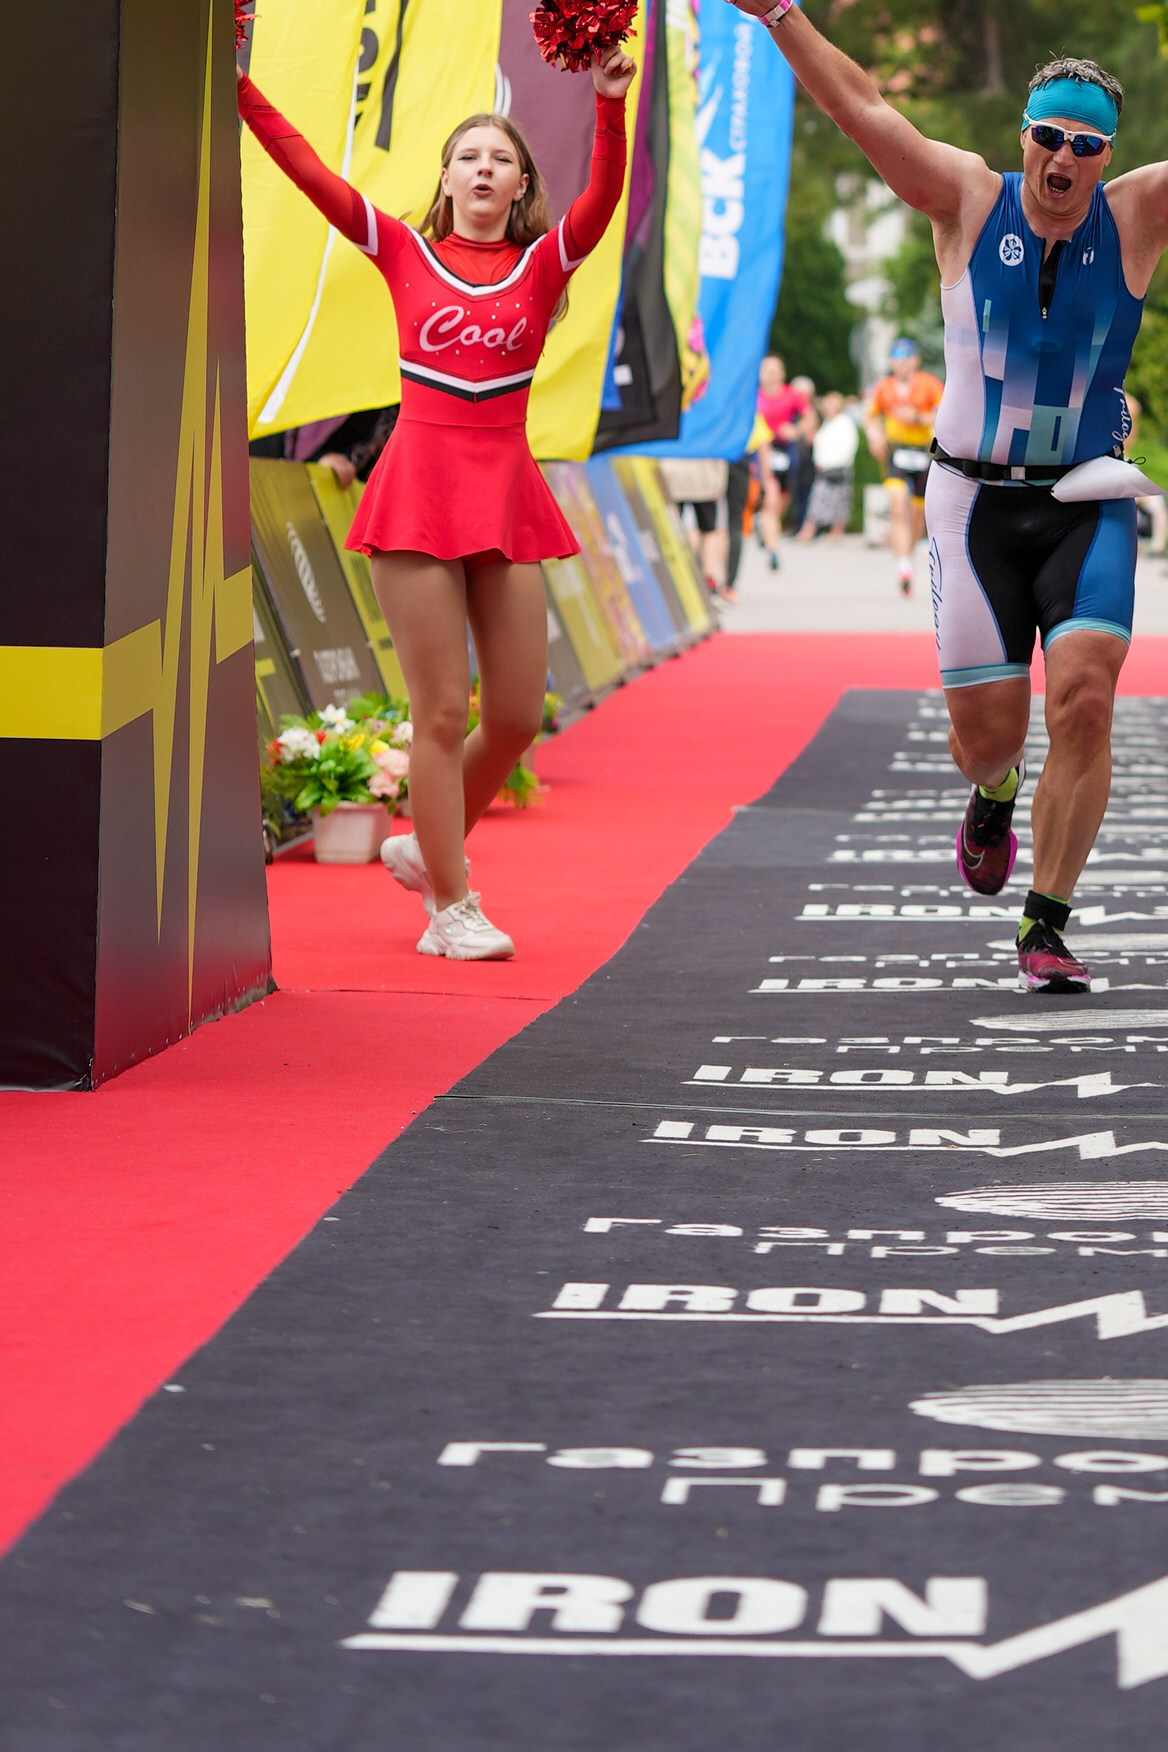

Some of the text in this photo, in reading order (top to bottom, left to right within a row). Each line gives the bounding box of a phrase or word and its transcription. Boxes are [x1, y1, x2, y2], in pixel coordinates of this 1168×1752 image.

[418, 305, 528, 352] Cool
[758, 977, 1022, 990] IRON
[692, 1064, 1010, 1085] IRON
[650, 1120, 1000, 1146] IRON
[551, 1282, 1000, 1315] IRON
[367, 1570, 986, 1637] IRON
